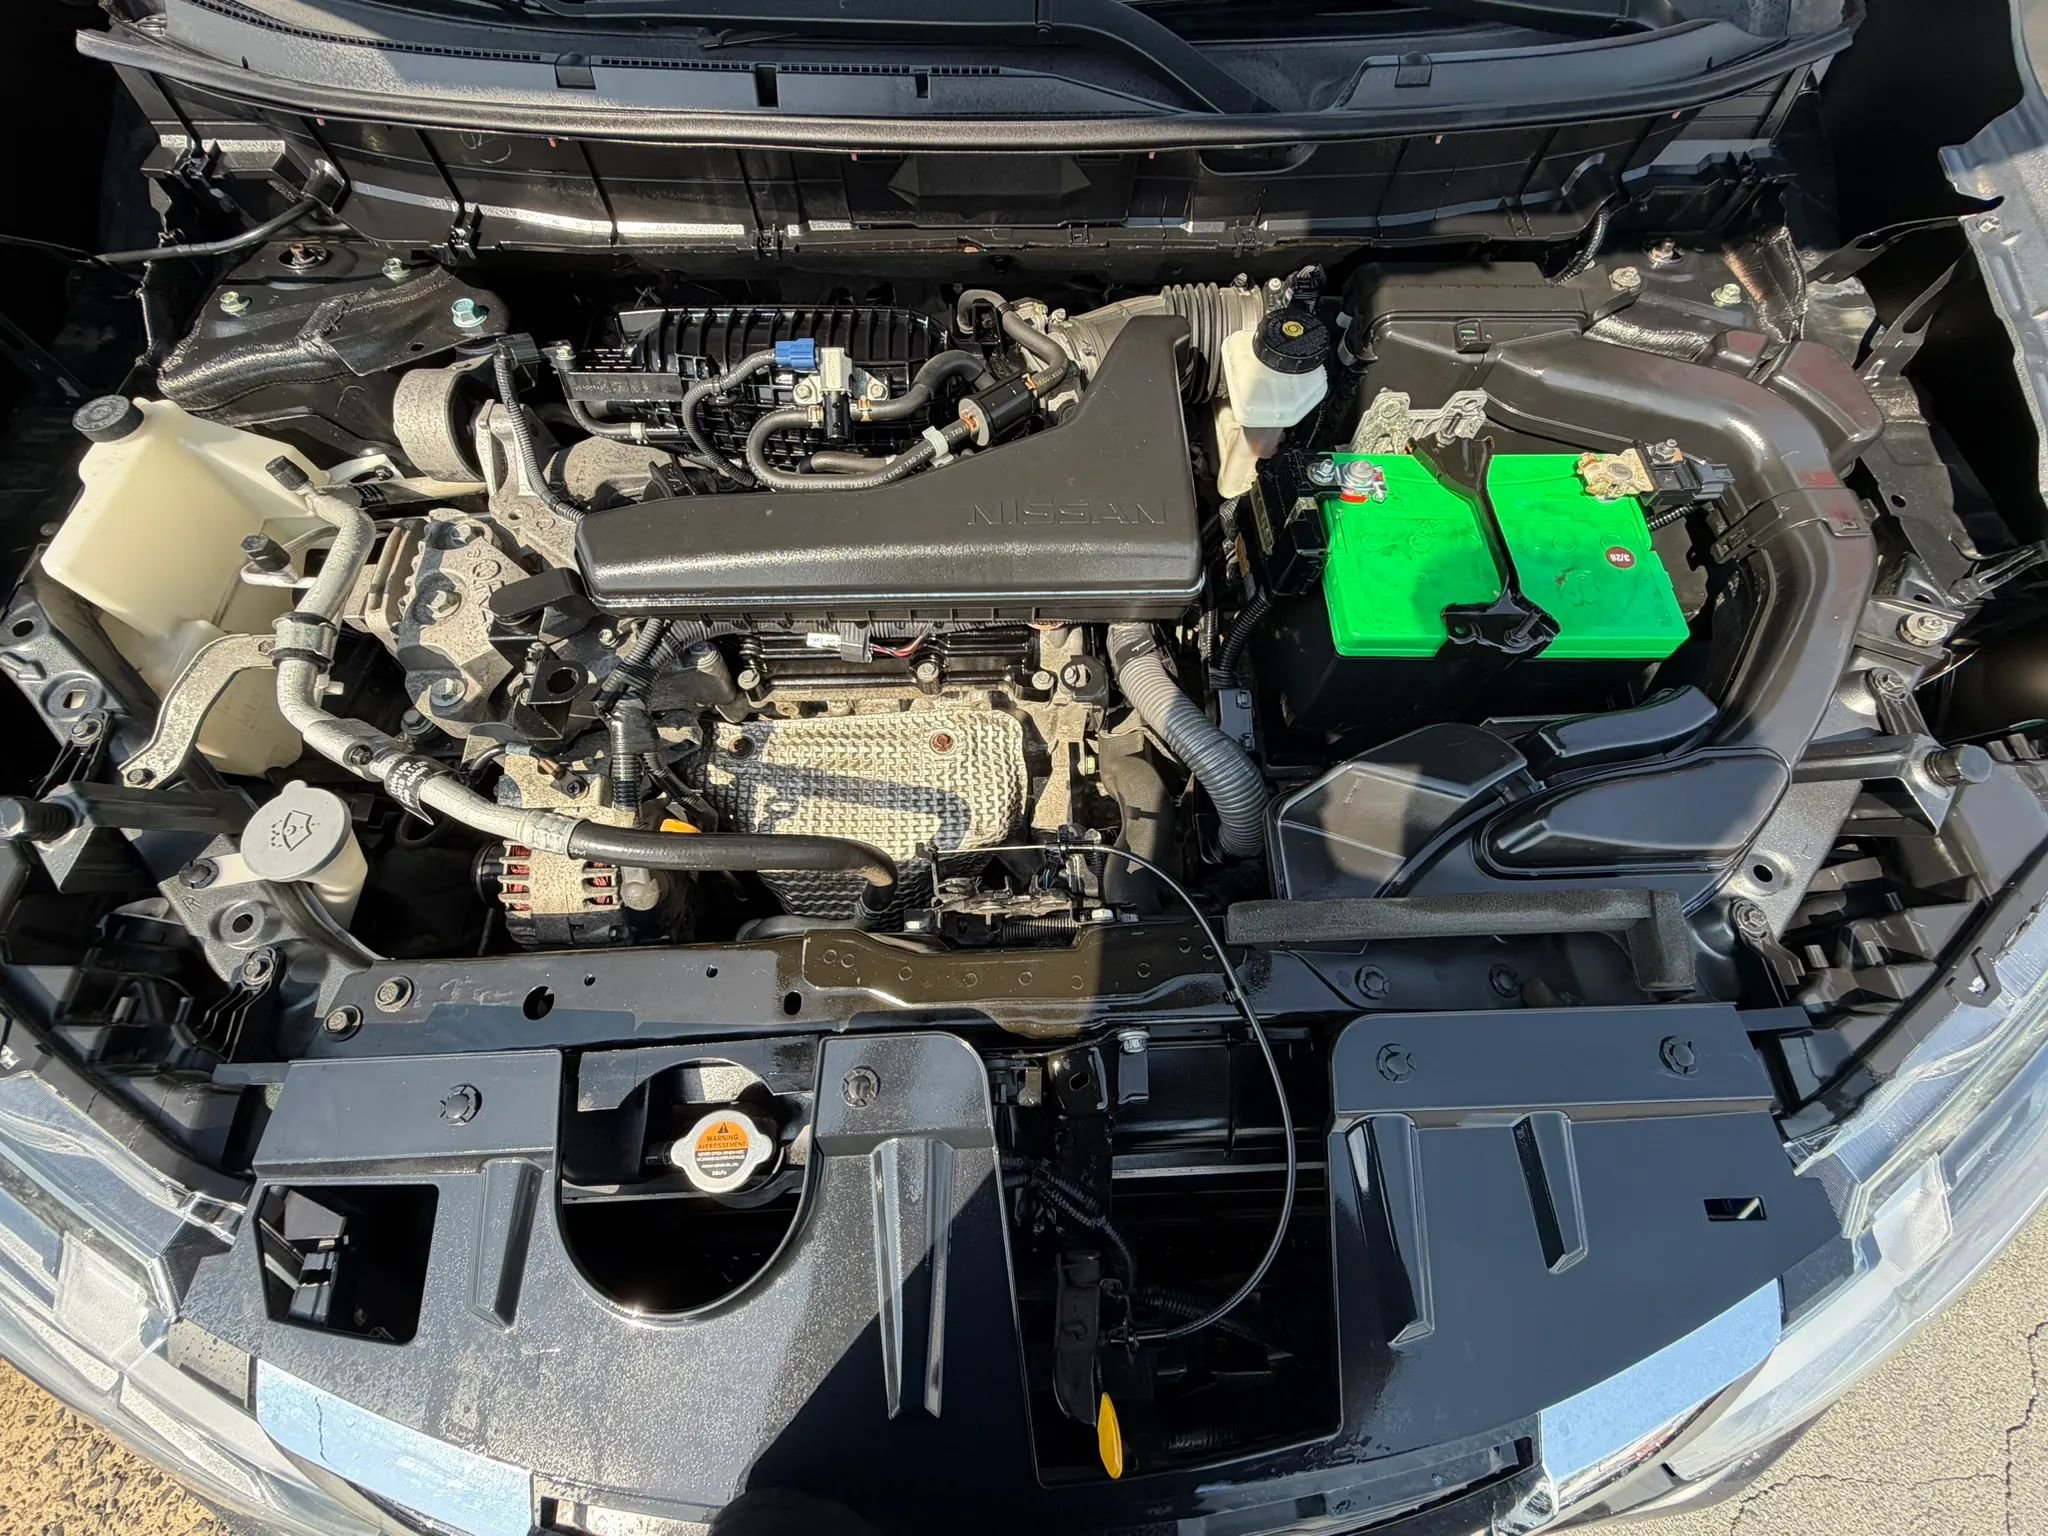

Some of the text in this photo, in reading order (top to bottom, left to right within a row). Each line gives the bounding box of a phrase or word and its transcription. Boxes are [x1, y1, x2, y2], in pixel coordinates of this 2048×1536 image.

[968, 499, 1167, 525] NISSAN
[182, 895, 201, 913] R
[697, 1141, 746, 1150] AVERTISSEMENT
